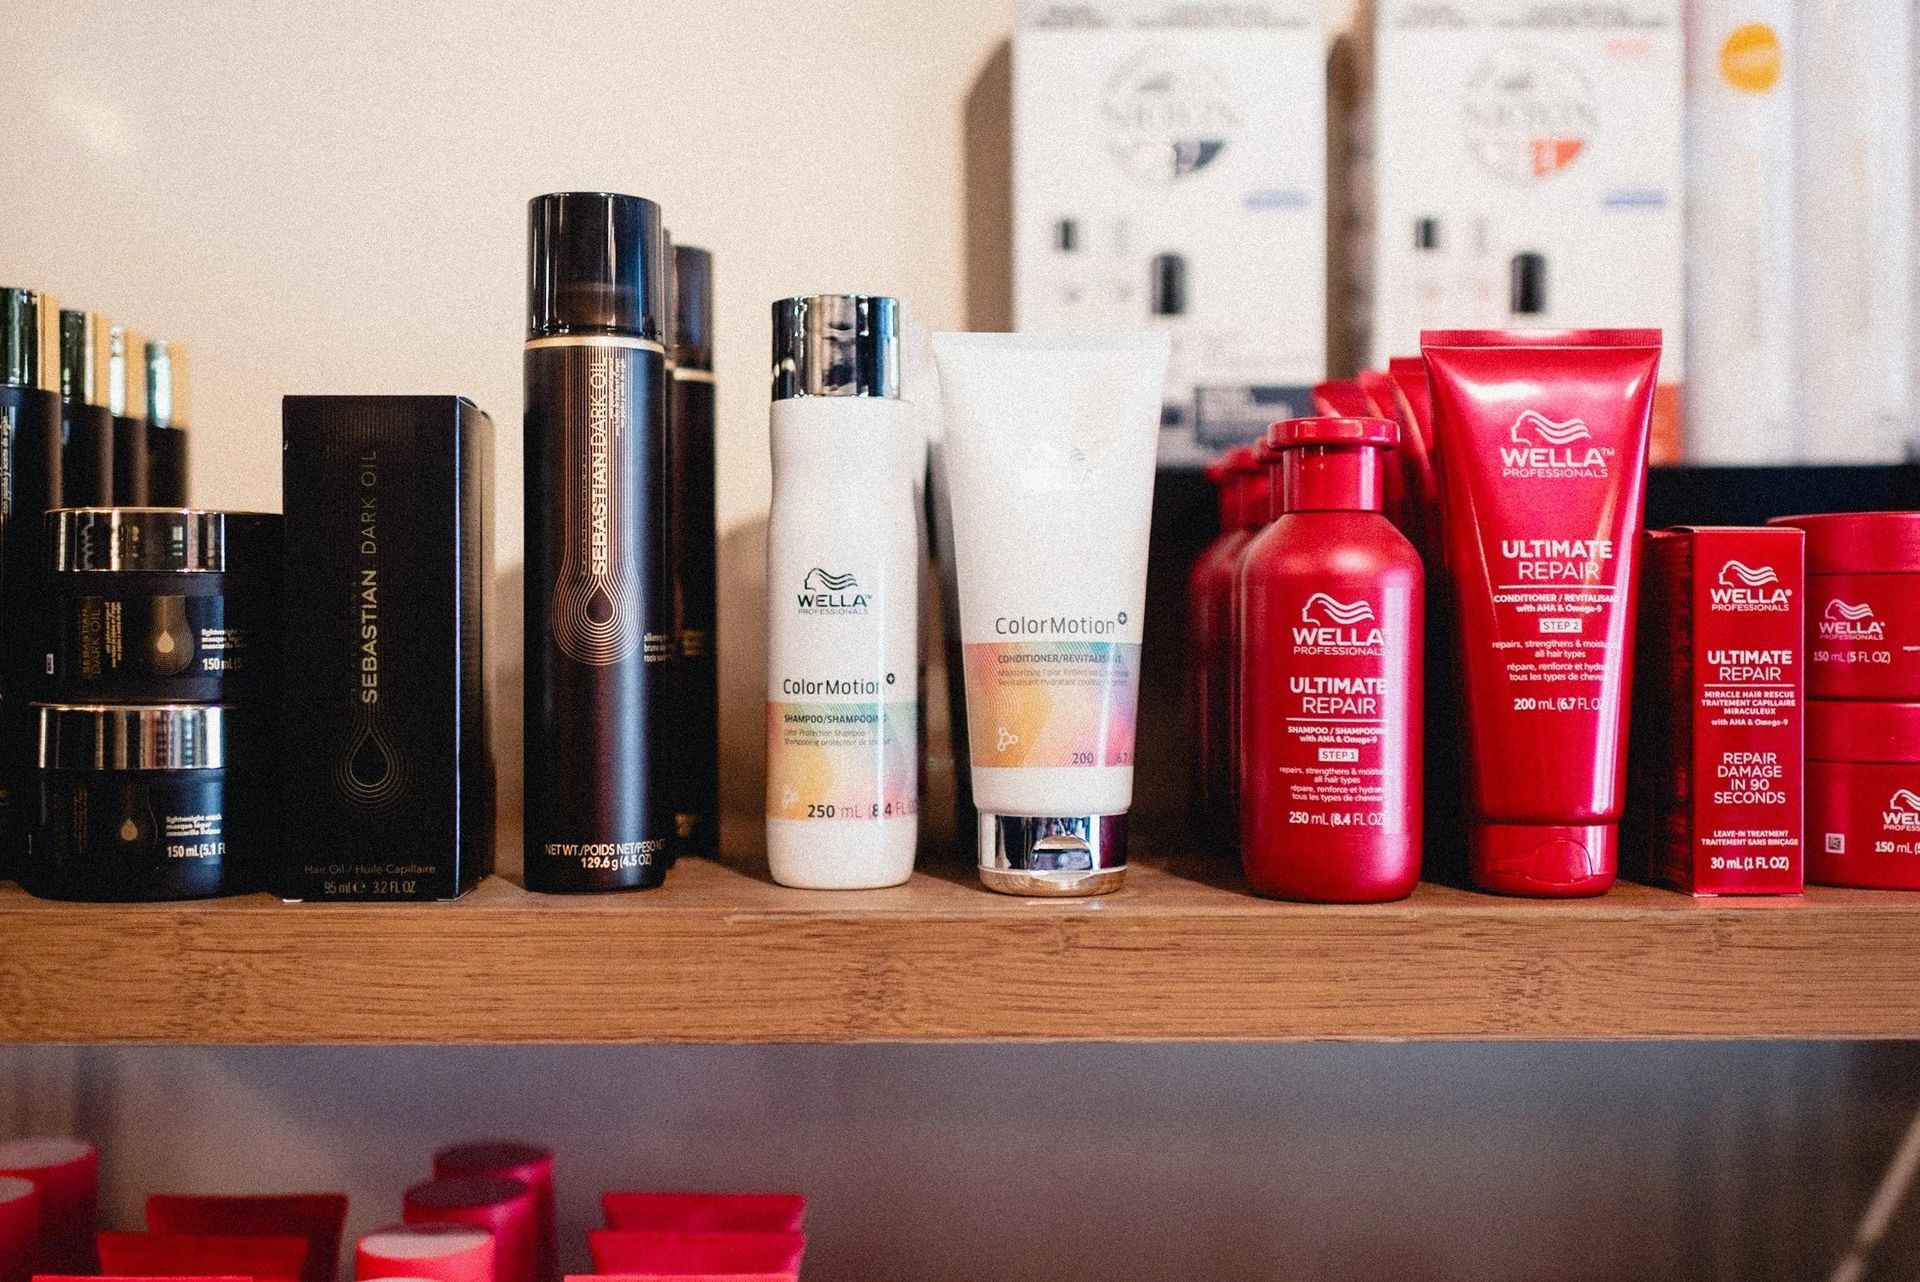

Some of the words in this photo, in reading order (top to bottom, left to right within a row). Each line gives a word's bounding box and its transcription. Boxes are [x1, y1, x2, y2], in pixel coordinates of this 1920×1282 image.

[591, 357, 607, 390] OIL
[591, 396, 607, 447] DARK
[361, 450, 377, 487] OIL
[1503, 468, 1609, 478] PROFESSIONALS
[591, 453, 607, 576] SEBASTIAN
[361, 498, 377, 554] DARK
[1502, 540, 1613, 559] ULTIMATE
[1519, 561, 1600, 580] REPAIR
[1493, 594, 1557, 603] CONDITIONER
[798, 608, 870, 616] PROFESSIONALS
[1516, 604, 1536, 613] with
[1537, 604, 1556, 613] AHA
[1565, 604, 1603, 615] Omega-9
[1711, 603, 1790, 612] PROFESSIONALS
[995, 616, 1116, 635] ColorMotion
[1543, 621, 1571, 631] STEP
[1573, 621, 1580, 631] 2
[361, 570, 378, 704] SEBASTIAN
[1292, 627, 1386, 646] WELLA
[1293, 646, 1387, 656] PROFESSIONALS
[1524, 640, 1574, 650] strengthens
[1535, 650, 1545, 659] all
[1546, 650, 1563, 659] hair
[1563, 650, 1587, 660] types
[1707, 650, 1793, 665] ULTIMATE
[1813, 651, 1829, 662] 150
[1831, 652, 1846, 663] mL
[1847, 651, 1857, 664] (5
[1858, 651, 1871, 663] FL
[202, 657, 221, 671] 150
[1538, 661, 1573, 671] renforce
[1575, 662, 1583, 671] et
[1584, 662, 1608, 673] hydr
[1509, 672, 1528, 682] tous
[1530, 672, 1542, 681] les
[1543, 672, 1567, 683] types
[1567, 672, 1579, 681] de
[1580, 672, 1606, 681] cheve
[1719, 667, 1782, 681] REPAIR
[1290, 676, 1391, 695] ULTIMATE
[1704, 690, 1741, 699] MIRACLE
[1742, 690, 1763, 699] HAIR
[1763, 690, 1795, 699] RESCUE
[1302, 696, 1377, 715] REPAIR
[1513, 697, 1536, 711] 200
[1538, 698, 1556, 711] mL
[1557, 697, 1577, 712] (6.7
[1578, 698, 1590, 711] FL
[1701, 699, 1751, 707] TRAITEMENT
[1751, 699, 1796, 707] CAPILLAIRE
[1723, 707, 1777, 715] MIRACULEUX
[784, 714, 889, 724] SHAMPOO/SHAMPOOI
[1711, 718, 1728, 726] with
[1729, 718, 1746, 726] AHA
[1754, 718, 1789, 727] Omega-9
[1287, 725, 1329, 735] SHAMPOO
[1335, 727, 1390, 736] SHAMPOOIN
[1299, 735, 1317, 743] with
[1317, 735, 1336, 743] AHA
[1072, 752, 1094, 764] 200
[1322, 751, 1348, 760] STEP
[1350, 751, 1355, 760] 1
[1723, 752, 1777, 765] REPAIR
[1305, 767, 1350, 777] strengthens
[1717, 765, 1783, 778] DAMAGE
[1324, 776, 1340, 784] hair
[1340, 776, 1361, 786] types
[1730, 778, 1746, 791] IN
[1750, 778, 1770, 791] 90
[1359, 786, 1386, 796] hydrat
[1713, 791, 1786, 804] SECONDS
[1321, 794, 1342, 803] types
[1343, 794, 1353, 802] de
[1354, 794, 1385, 802] cheveu
[807, 804, 835, 818] 250
[839, 804, 863, 818] mL
[868, 802, 892, 819] (84
[1289, 811, 1309, 825] 250
[1311, 812, 1329, 825] mL
[1330, 812, 1352, 827] (8.4
[1353, 813, 1367, 826] FL
[1713, 830, 1746, 838] LEAVE-IN
[1746, 830, 1789, 838] TREATMENT
[1701, 838, 1747, 846] TRAITEMENT
[1747, 838, 1767, 846] SANS
[1875, 840, 1895, 853] 150
[1896, 842, 1914, 854] mL
[166, 844, 185, 859] 150
[185, 844, 199, 858] mL
[544, 844, 561, 856] NET
[581, 856, 611, 869] 129.6
[611, 858, 619, 871] g
[620, 854, 638, 869] (4.5
[1710, 856, 1725, 870] 30
[1726, 856, 1743, 870] mL
[1744, 856, 1754, 871] (1
[1755, 857, 1769, 869] FL
[1769, 856, 1790, 871] OZ)
[304, 864, 326, 875] Hair
[328, 863, 345, 875] Oil
[355, 863, 383, 875] Huile
[385, 863, 436, 876] Capillaire
[324, 881, 337, 895] 95
[372, 881, 387, 894] 3.2
[389, 881, 400, 894] FL
[402, 880, 417, 894] OZ
